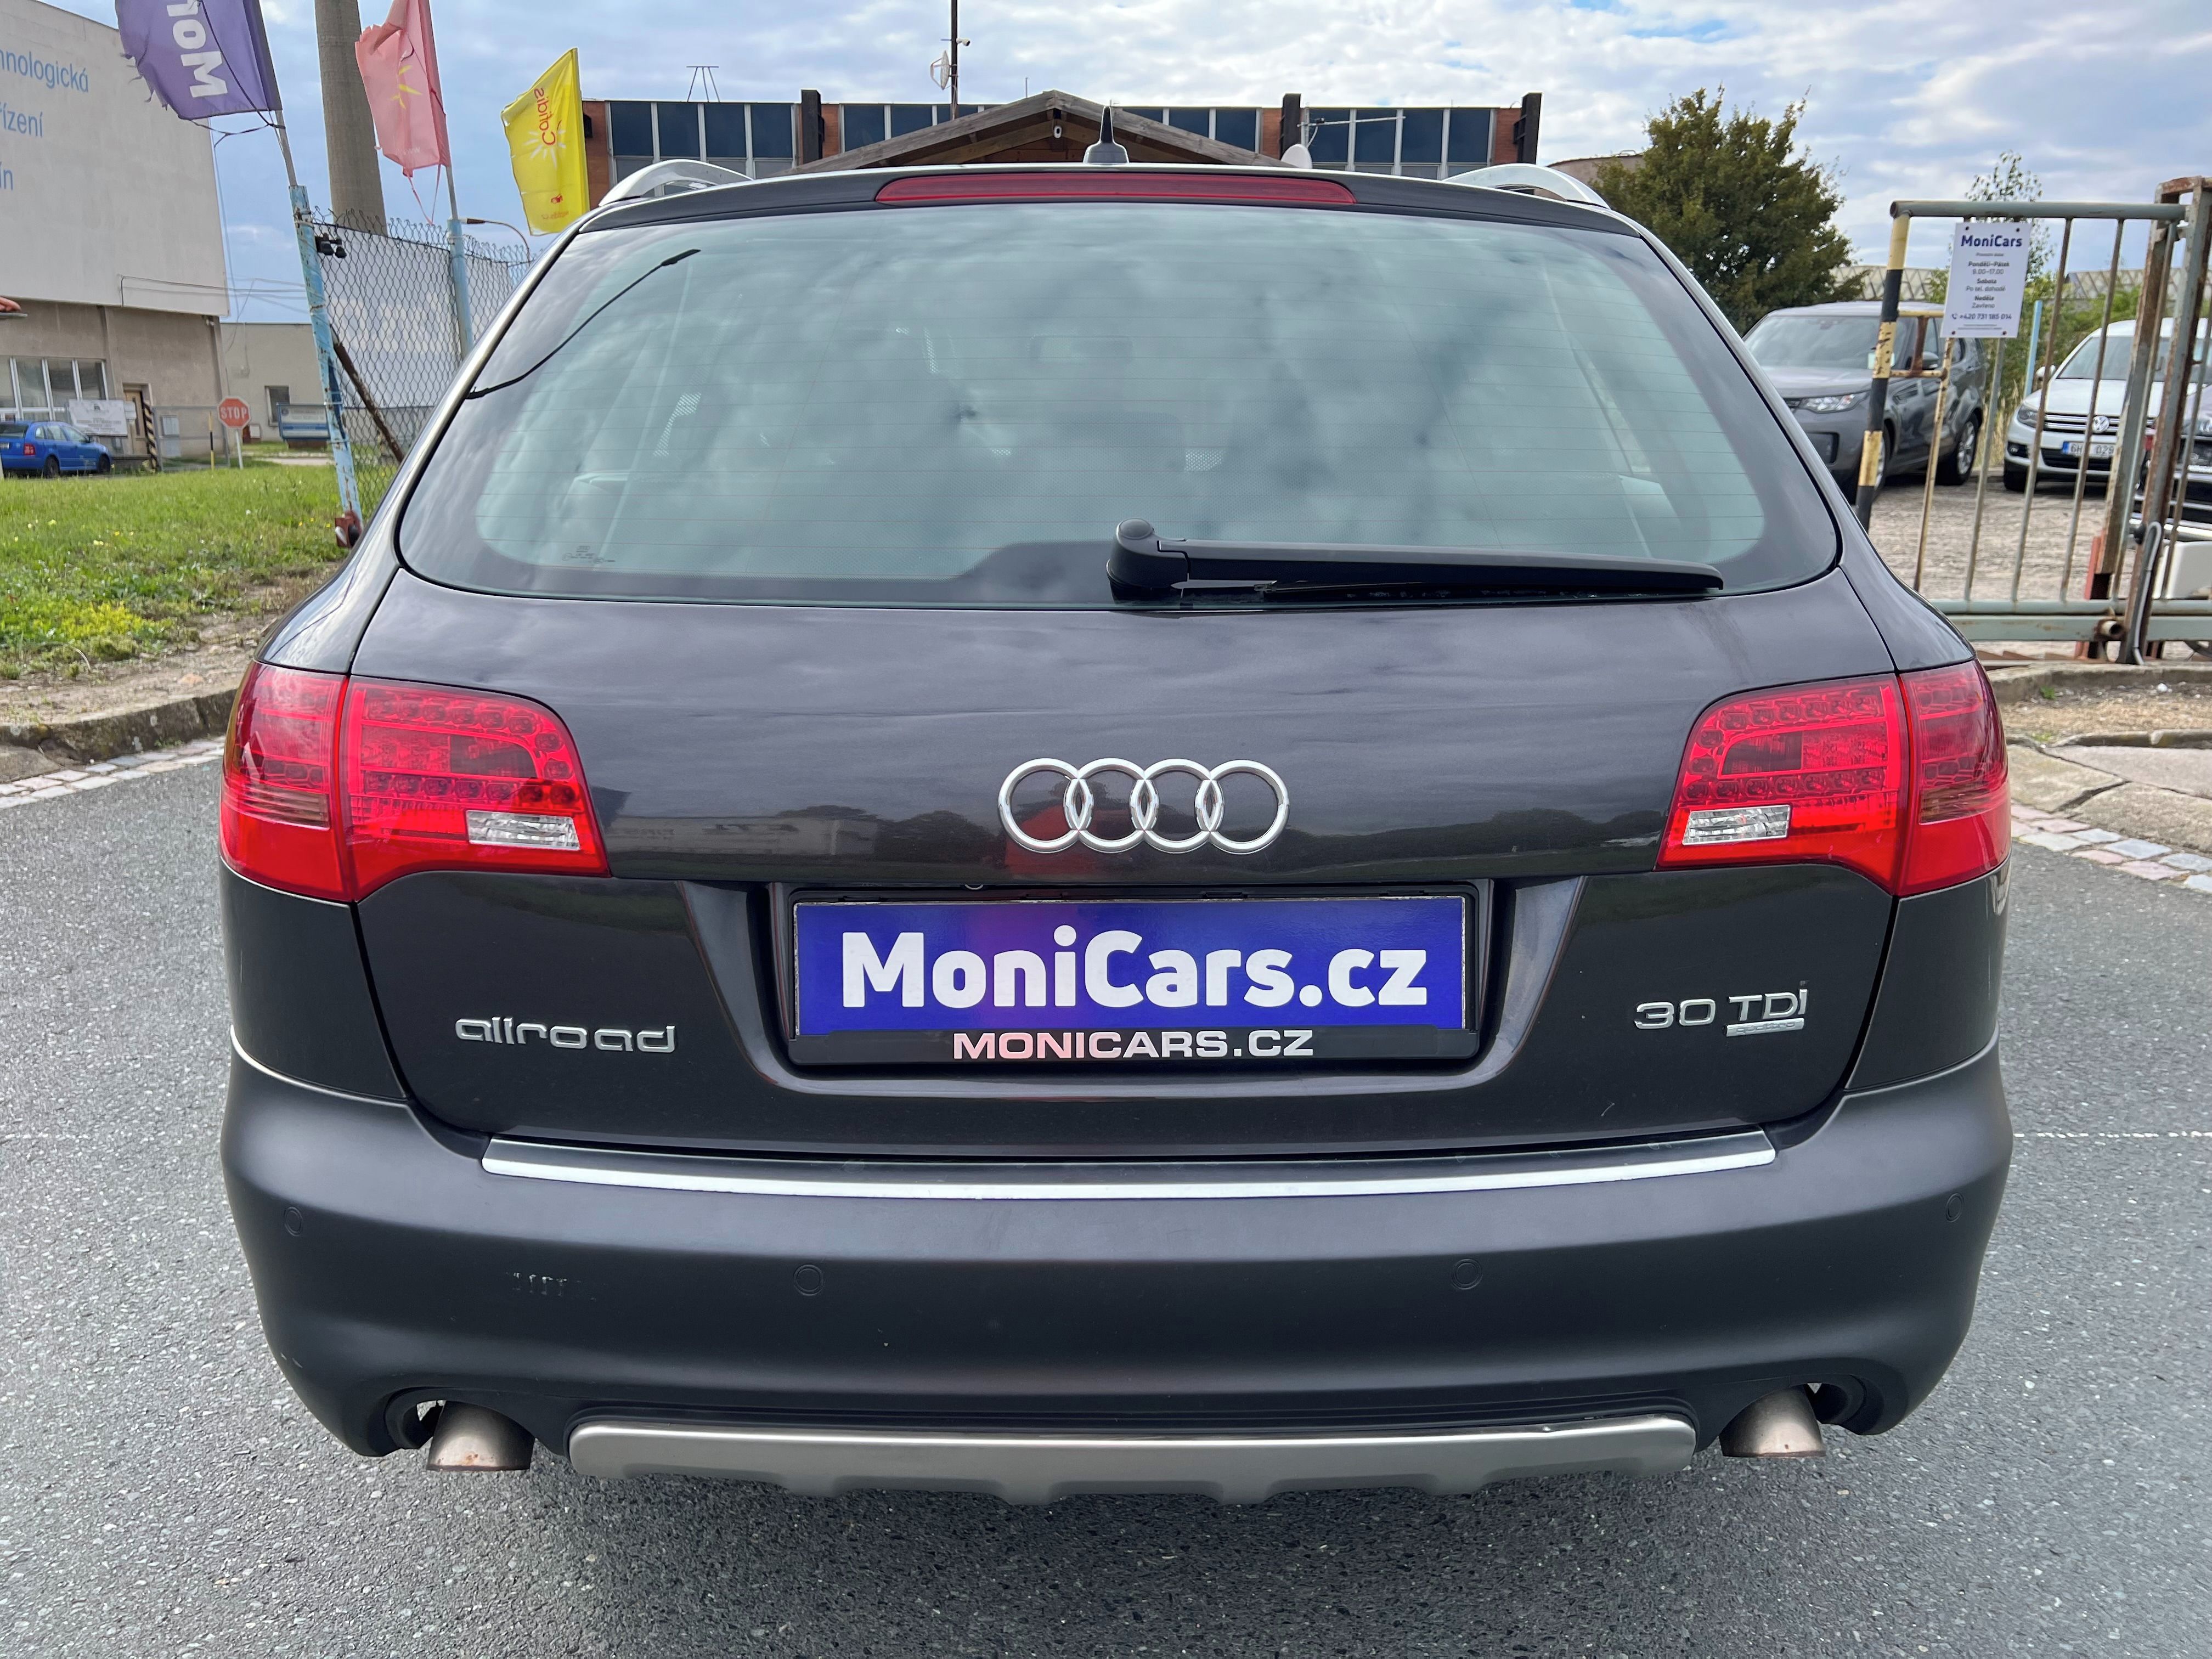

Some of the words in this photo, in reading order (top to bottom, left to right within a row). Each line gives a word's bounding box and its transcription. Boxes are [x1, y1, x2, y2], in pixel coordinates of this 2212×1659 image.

[1961, 234, 2022, 247] MoniCars
[221, 406, 247, 420] STOP
[843, 924, 1426, 1008] MoniCars.cz
[455, 1016, 675, 1053] allroad
[953, 1029, 1313, 1059] MONICARS.CZ
